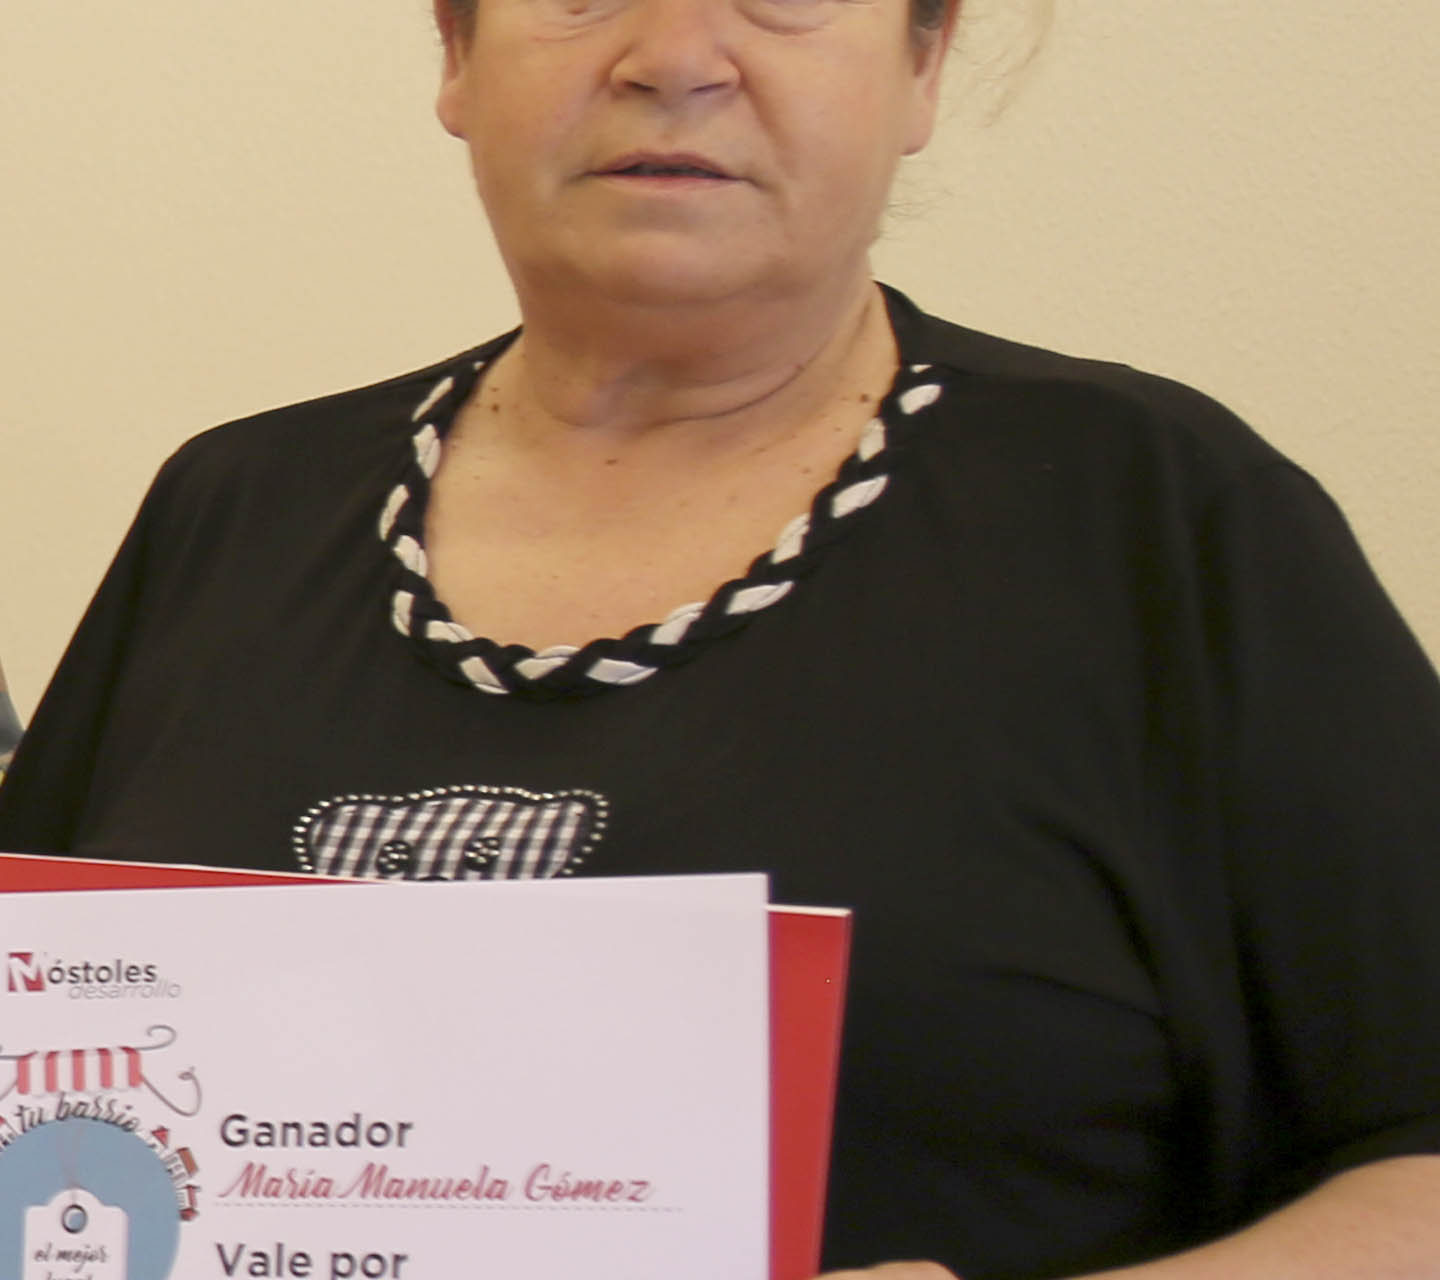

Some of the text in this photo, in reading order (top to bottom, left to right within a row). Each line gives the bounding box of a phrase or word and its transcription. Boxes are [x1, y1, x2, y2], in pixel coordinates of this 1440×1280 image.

[68, 979, 182, 1000] desarrollo
[14, 1091, 147, 1133] tu barrio
[219, 1112, 415, 1148] Ganador
[217, 1161, 654, 1203] María Manuela Gómez
[34, 1241, 108, 1274] el mejor
[215, 1242, 312, 1278] Vale
